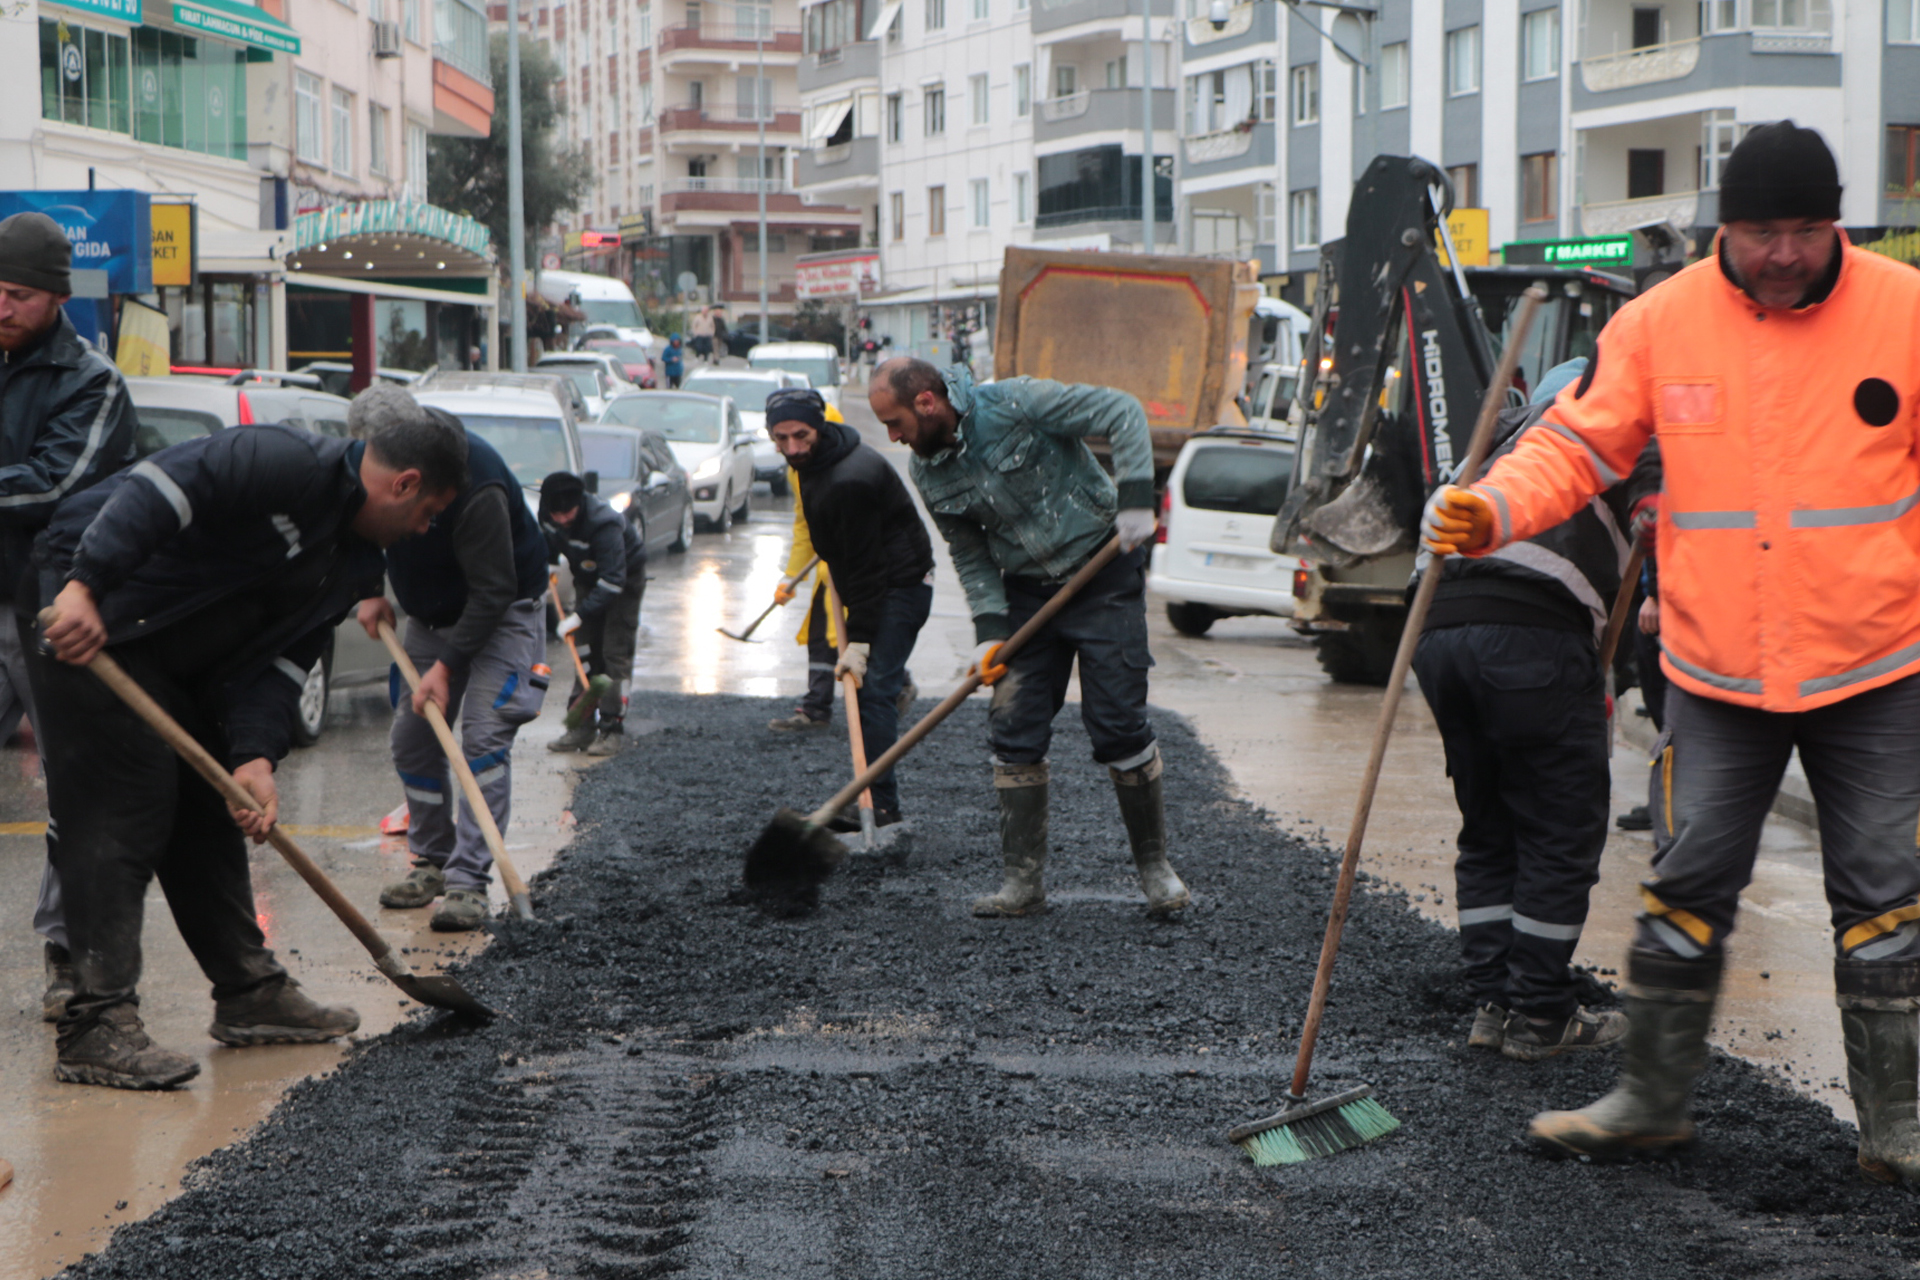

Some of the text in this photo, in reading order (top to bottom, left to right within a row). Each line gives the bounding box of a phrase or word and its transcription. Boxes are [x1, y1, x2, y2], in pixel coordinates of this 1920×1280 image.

[295, 205, 344, 250] FIRAT
[75, 242, 111, 257] GIDA
[1557, 242, 1627, 260] MARKET
